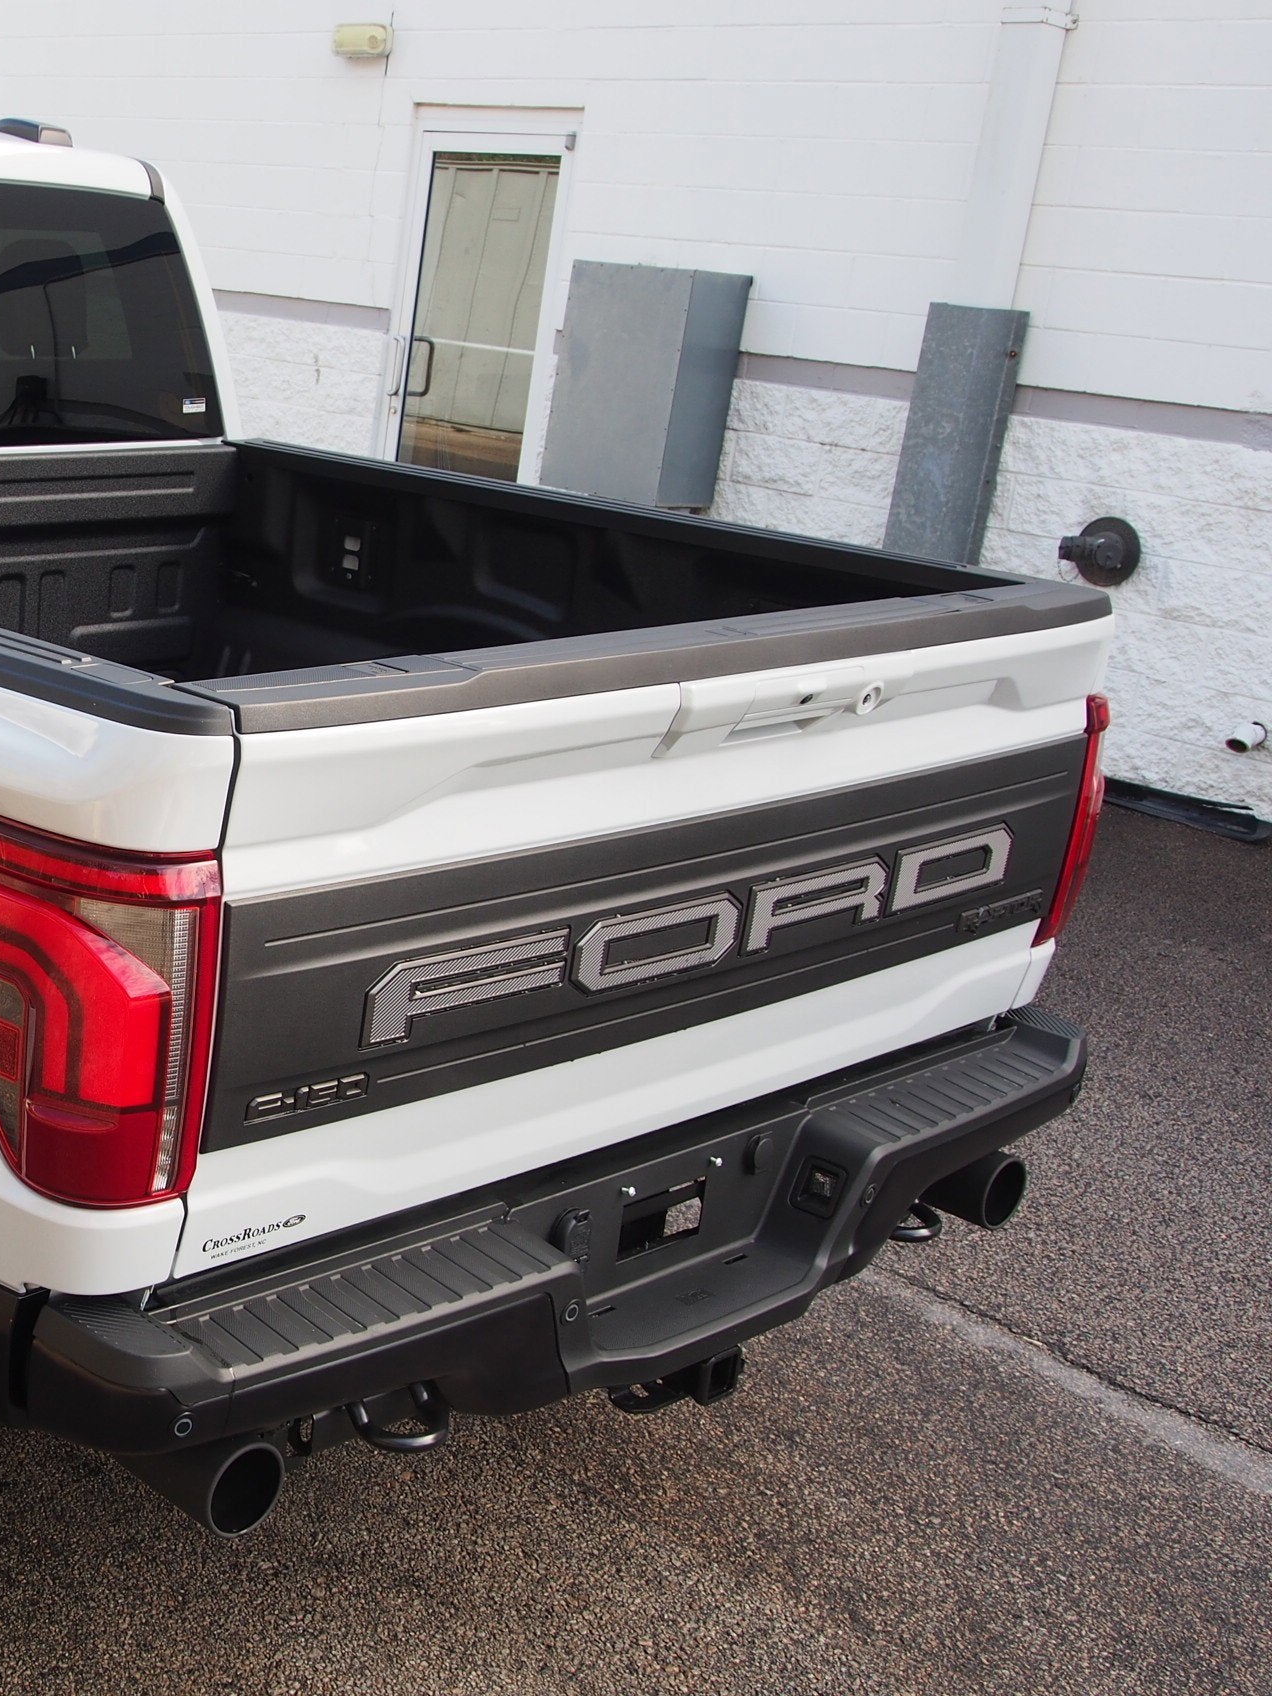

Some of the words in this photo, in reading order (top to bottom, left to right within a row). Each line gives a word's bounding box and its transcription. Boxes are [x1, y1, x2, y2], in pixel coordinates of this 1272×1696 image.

[358, 820, 1015, 1050] FORD
[244, 1071, 370, 1125] F-150
[210, 1249, 229, 1259] WAKE
